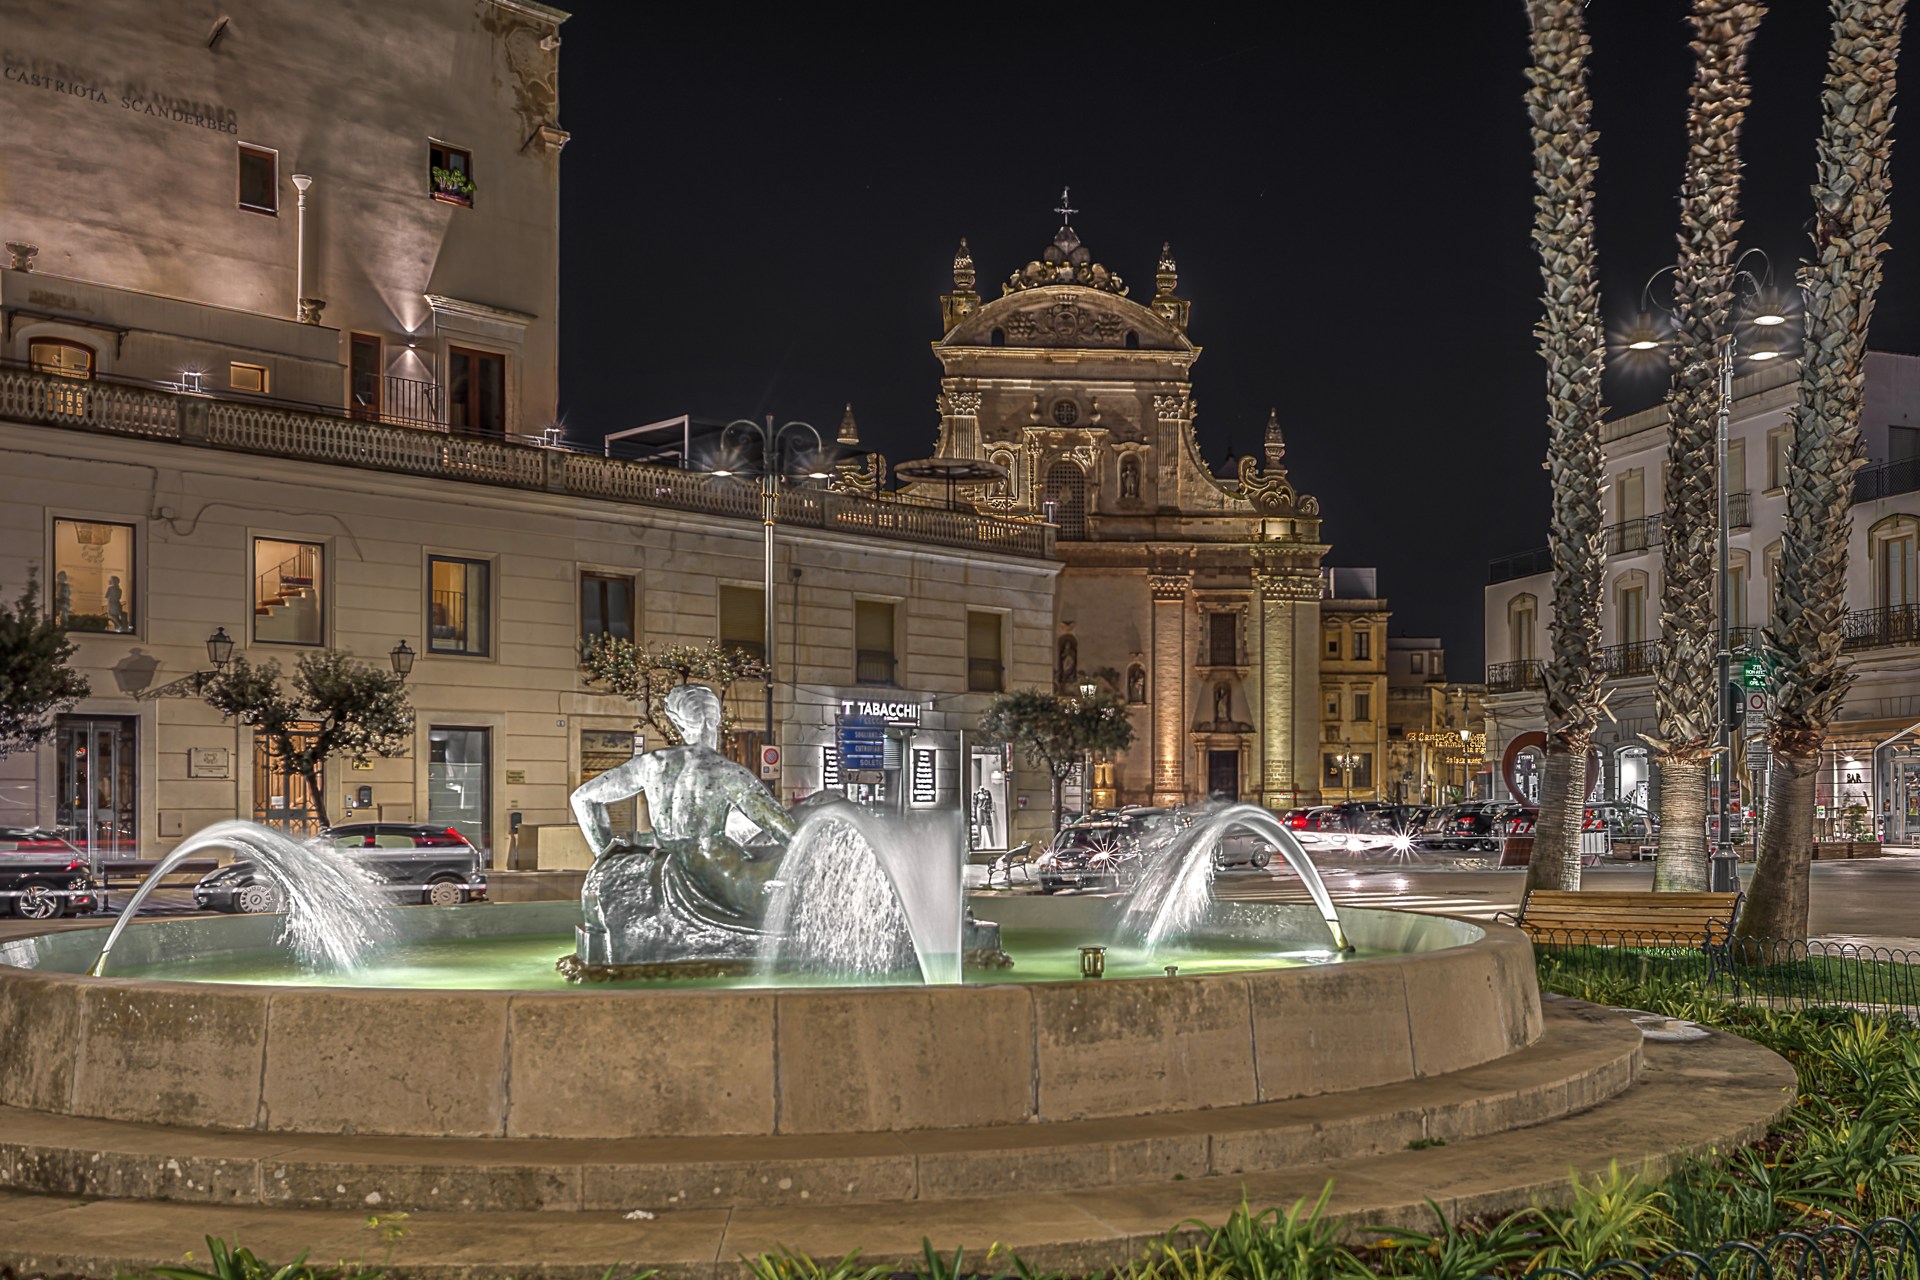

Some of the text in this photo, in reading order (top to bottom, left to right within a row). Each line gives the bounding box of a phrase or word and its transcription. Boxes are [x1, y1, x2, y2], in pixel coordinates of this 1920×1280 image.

[3, 66, 238, 135] CASTRIOTA SCANDERBEG
[857, 701, 916, 718] TABACCHI
[1847, 773, 1862, 783] BAR
